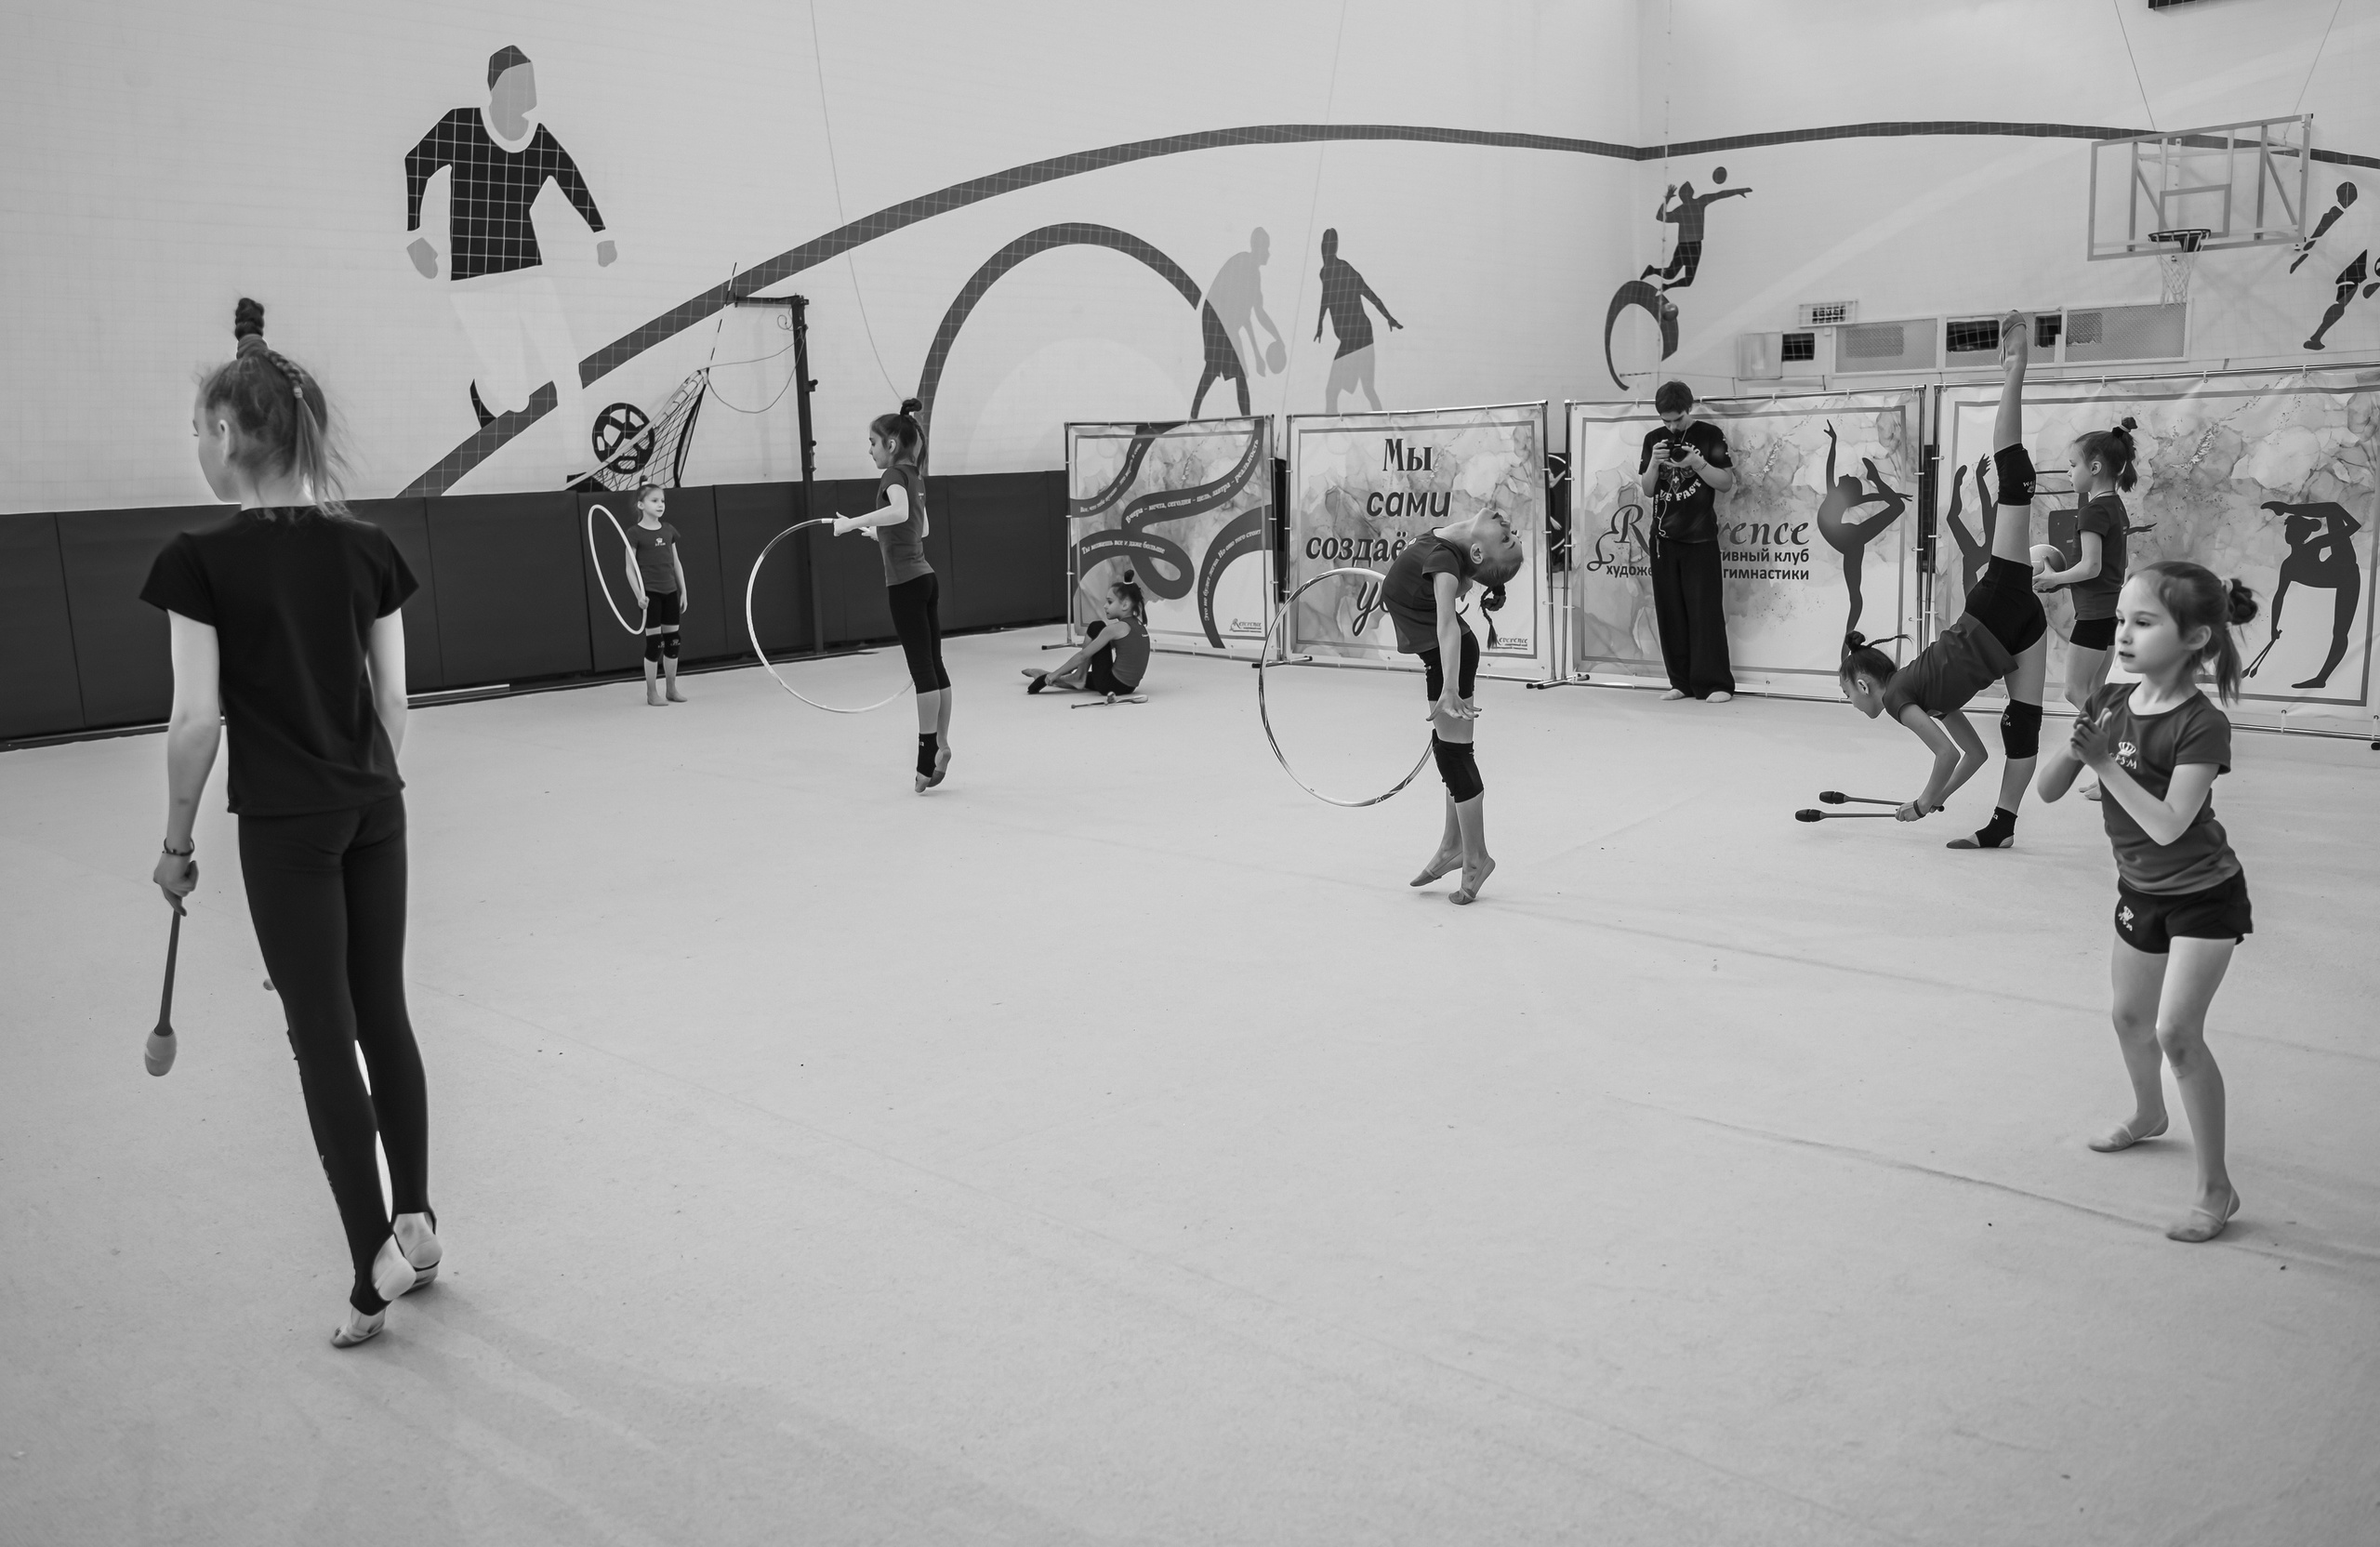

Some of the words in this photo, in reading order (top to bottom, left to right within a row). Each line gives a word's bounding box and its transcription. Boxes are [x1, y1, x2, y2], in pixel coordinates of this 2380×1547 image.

[1382, 438, 1433, 471] Мы
[1125, 509, 1144, 523] Вчера
[1167, 498, 1192, 508] сегодня
[1211, 483, 1231, 497] завтра
[1234, 439, 1260, 483] реальность
[1675, 479, 1702, 501] FAST
[1367, 492, 1452, 517] сами
[1081, 546, 1091, 554] Ты
[1091, 540, 1113, 550] можешь
[1143, 541, 1166, 554] больше
[1217, 549, 1226, 559] Но
[1246, 528, 1262, 538] стоит
[1306, 531, 1408, 568] создаё
[1774, 549, 1810, 565] клуб
[1723, 569, 1810, 580] гимнастики
